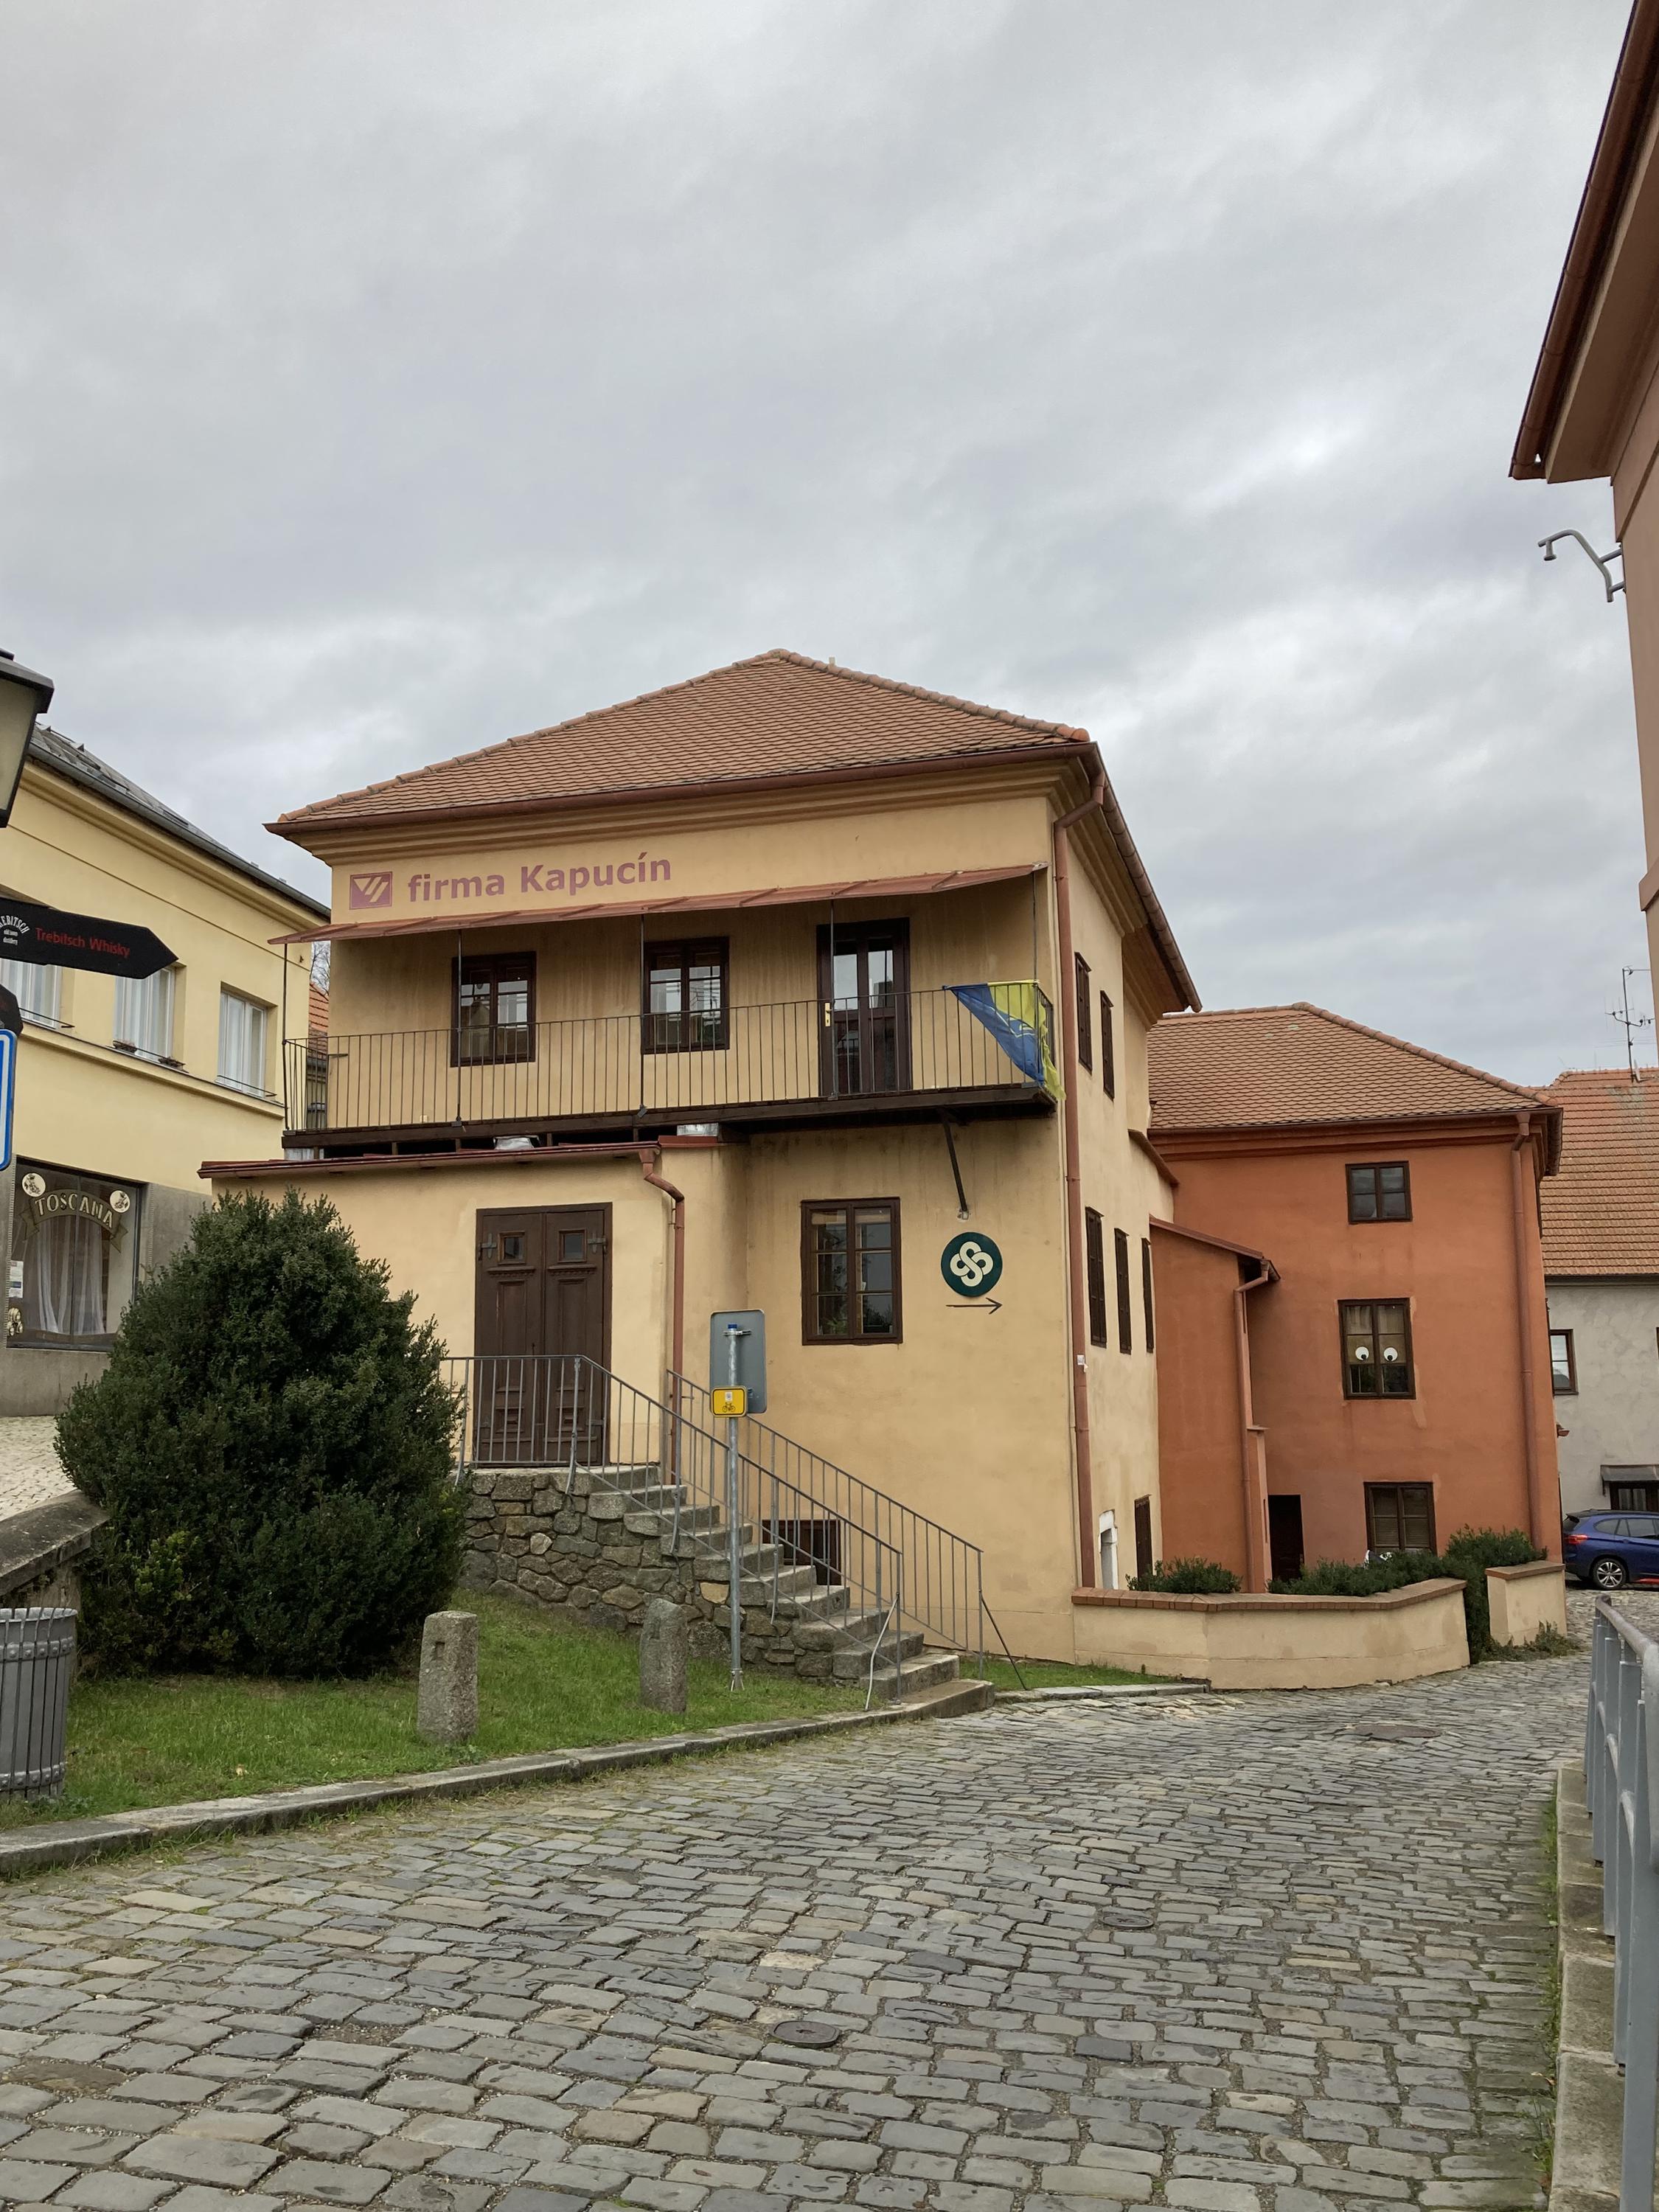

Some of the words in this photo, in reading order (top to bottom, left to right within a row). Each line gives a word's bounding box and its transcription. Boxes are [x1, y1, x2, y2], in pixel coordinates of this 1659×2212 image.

[408, 872, 505, 902] firma
[521, 852, 671, 896] Kapucín
[35, 928, 86, 948] Trebitsch
[90, 936, 131, 959] Whisky
[35, 1192, 113, 1229] TOSCANA
